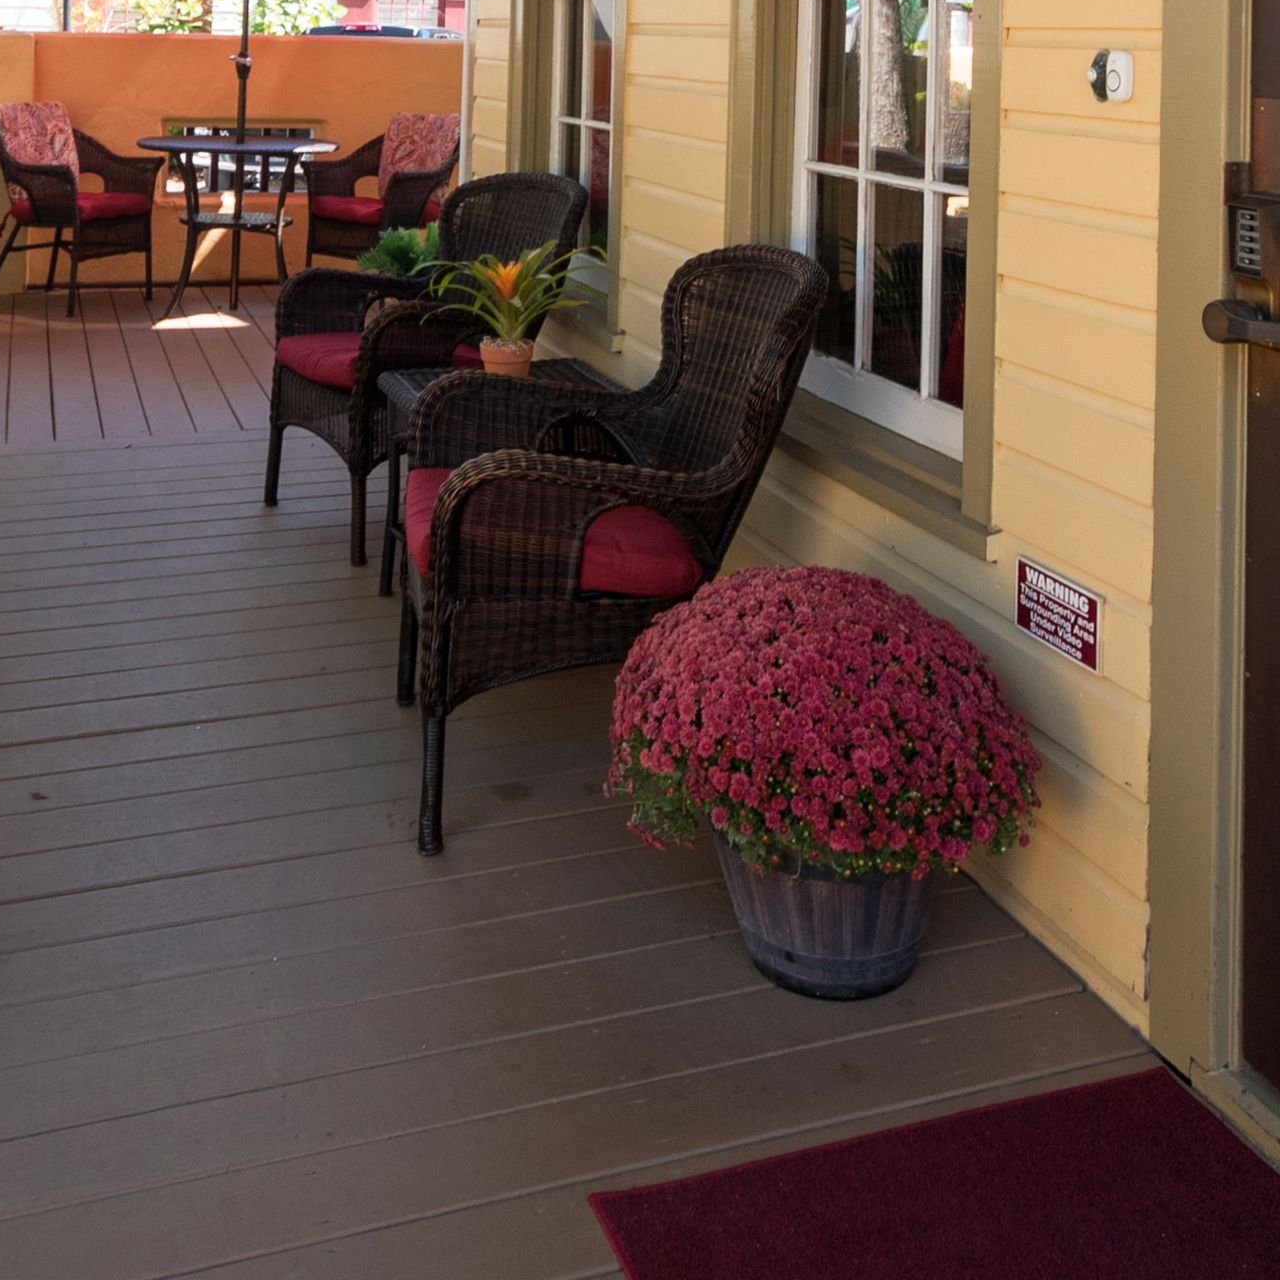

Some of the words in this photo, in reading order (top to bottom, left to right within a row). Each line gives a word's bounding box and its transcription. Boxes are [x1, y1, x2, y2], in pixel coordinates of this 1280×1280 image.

[1020, 583, 1038, 600] This
[1040, 594, 1076, 624] Property
[1077, 616, 1095, 632] and
[1025, 566, 1089, 613] WARNING
[1020, 594, 1072, 633] Surrounding
[1073, 624, 1094, 645] Area
[1030, 611, 1056, 633] Under
[1057, 626, 1082, 648] Video
[1030, 622, 1082, 659] Surveillance
